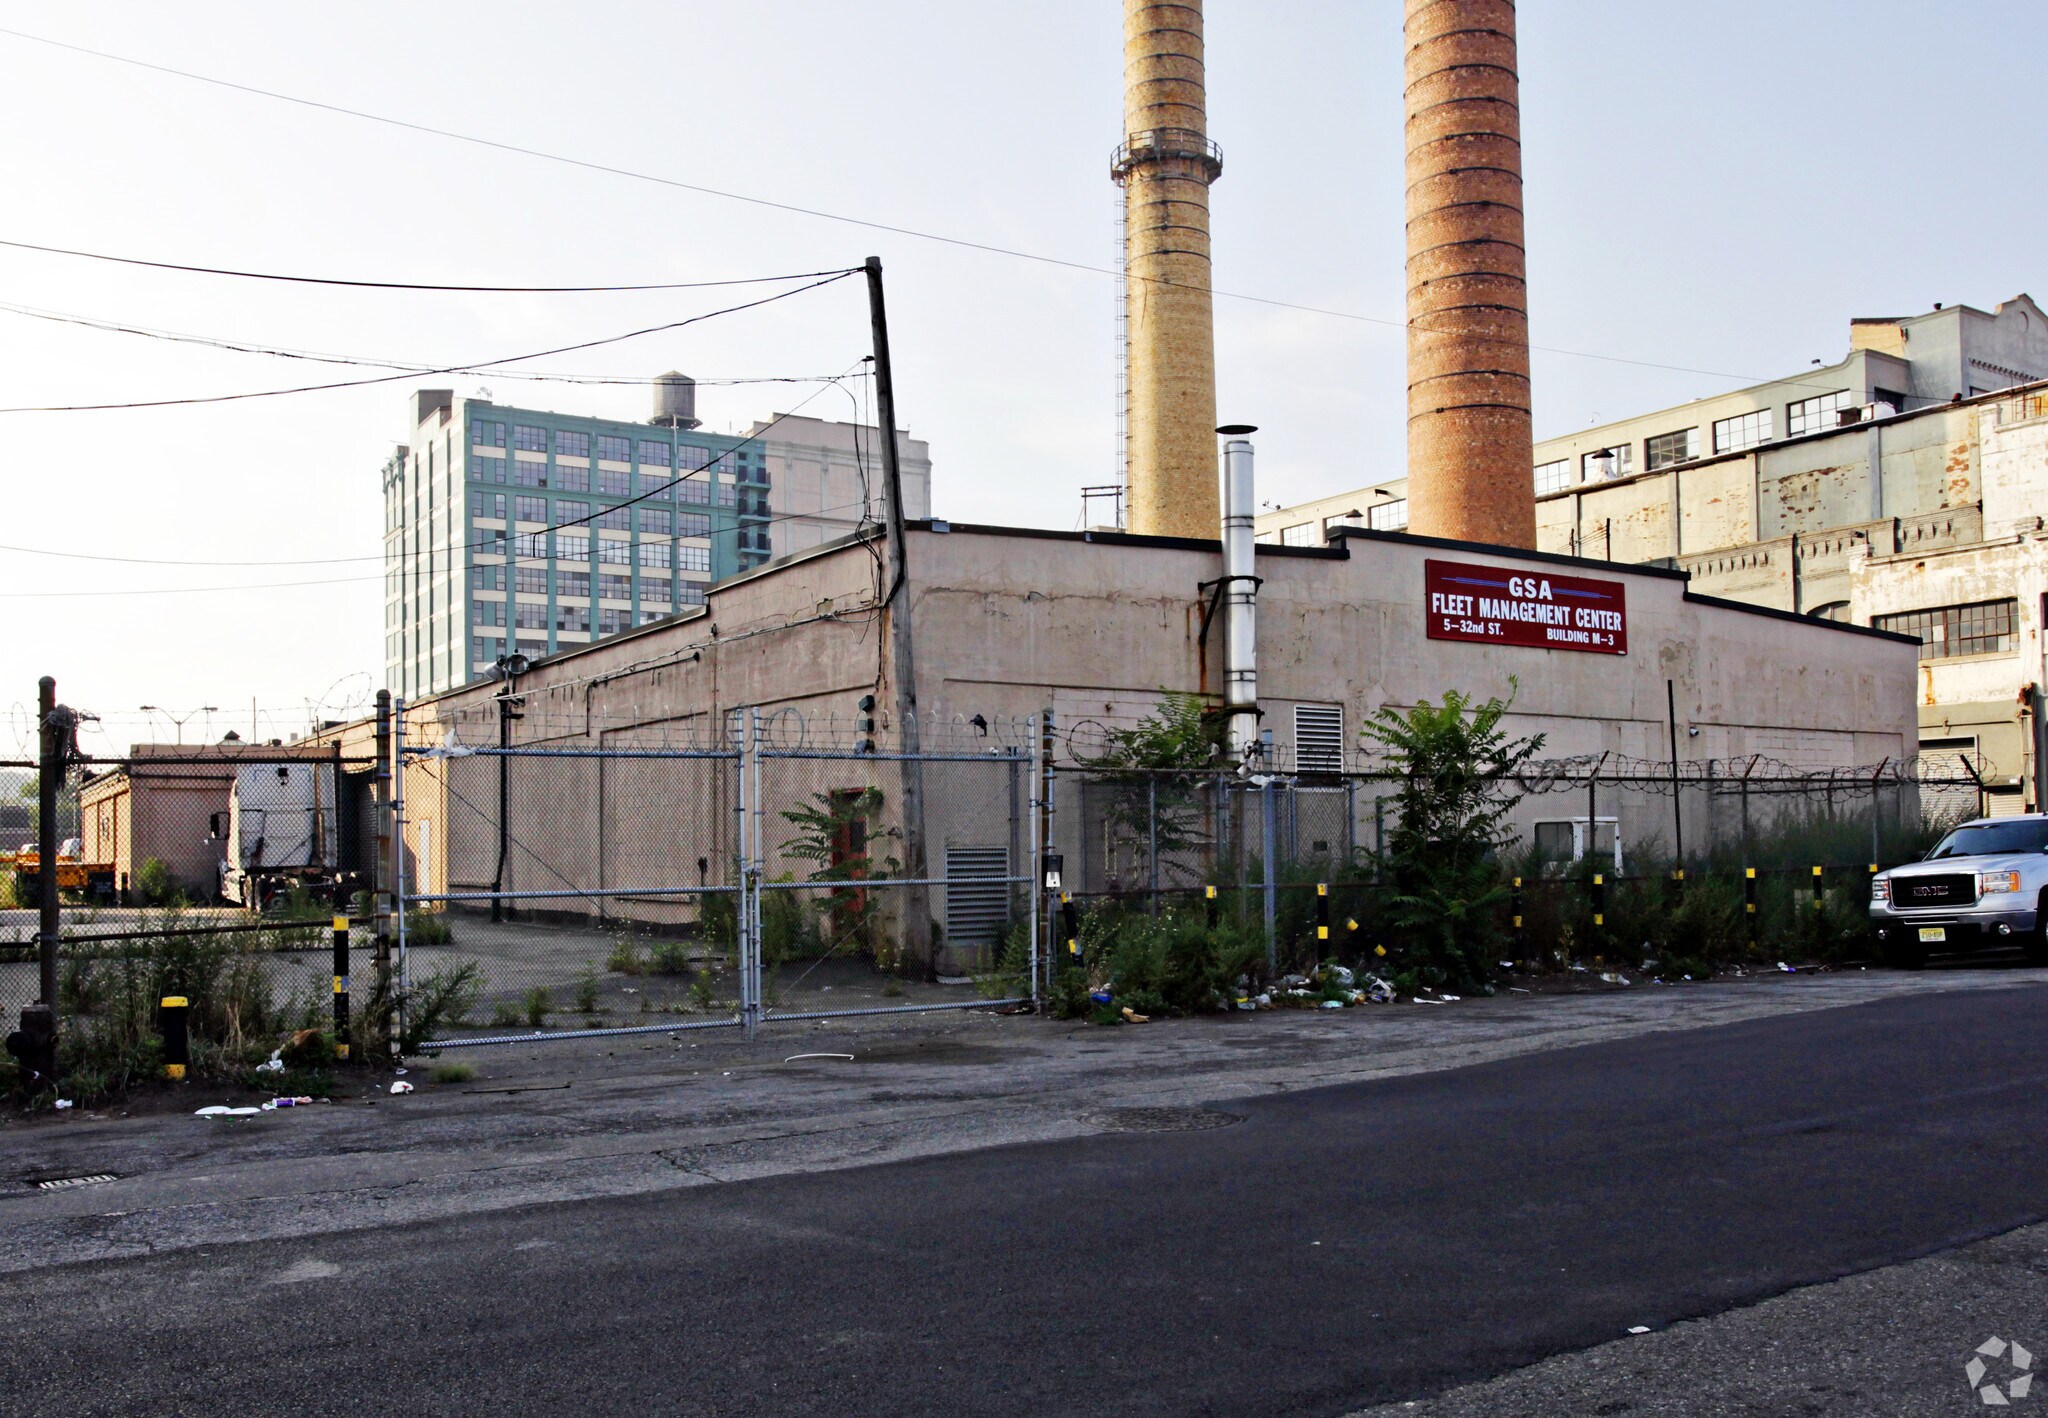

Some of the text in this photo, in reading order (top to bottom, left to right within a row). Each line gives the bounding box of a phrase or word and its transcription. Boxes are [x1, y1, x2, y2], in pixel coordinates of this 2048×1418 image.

[1508, 576, 1553, 600] GSA
[1432, 592, 1622, 632] FLEET MANAGEMENT CENTER
[1443, 618, 1504, 636] 5-32nd ST.
[1546, 627, 1614, 646] BUILDING M-3
[1913, 885, 1949, 897] GMC
